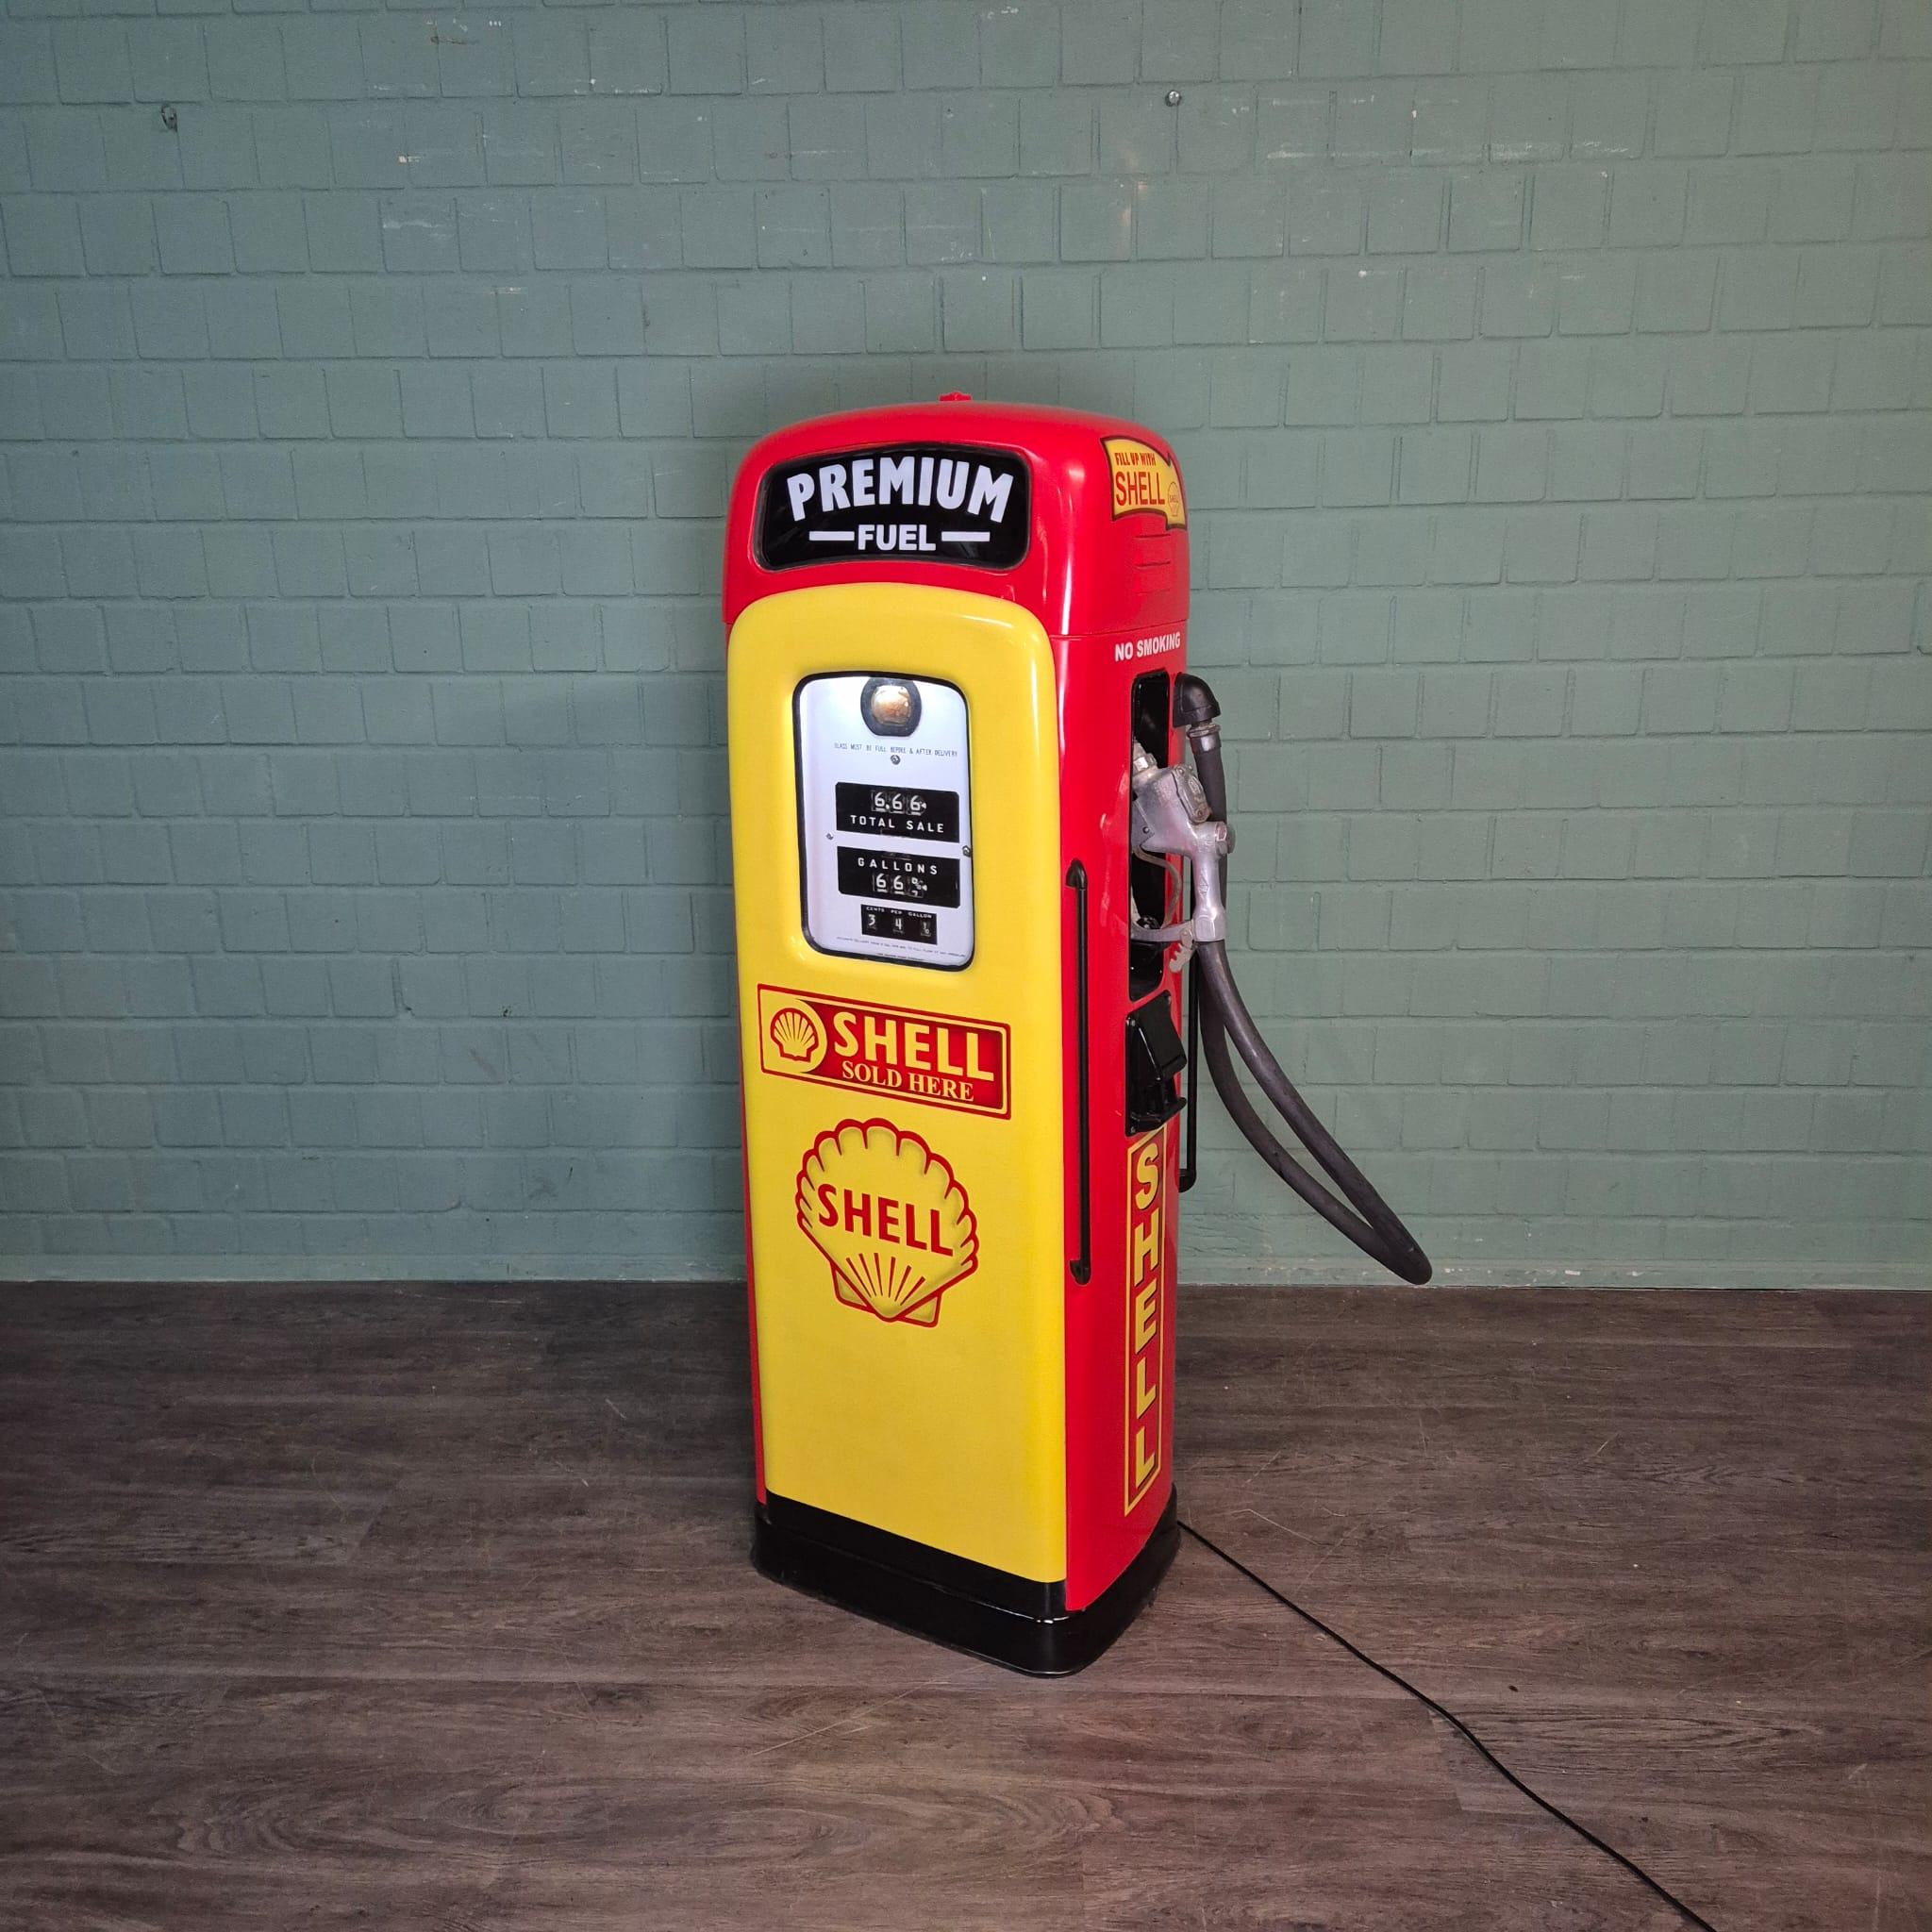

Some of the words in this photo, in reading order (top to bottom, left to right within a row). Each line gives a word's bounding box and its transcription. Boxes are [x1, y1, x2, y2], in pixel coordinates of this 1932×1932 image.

[1114, 452, 1130, 465] FILL
[1130, 452, 1140, 466] UP
[1140, 452, 1157, 466] WITH
[787, 456, 1014, 523] PREMIUM
[1115, 471, 1165, 507] SHELL
[858, 525, 936, 551] FUEL
[1114, 641, 1133, 662] NO
[1136, 631, 1181, 658] SMOKING
[850, 814, 895, 828] TOTAL
[906, 820, 944, 833] SALE
[858, 857, 938, 875] GALLONS
[868, 913, 875, 925] 3
[894, 917, 903, 930] 4
[833, 1011, 994, 1082] SHELL
[841, 1059, 903, 1088] SOLD
[908, 1072, 974, 1102] HERE
[818, 1183, 954, 1257] SHELL
[1134, 1142, 1160, 1489] SHELL
